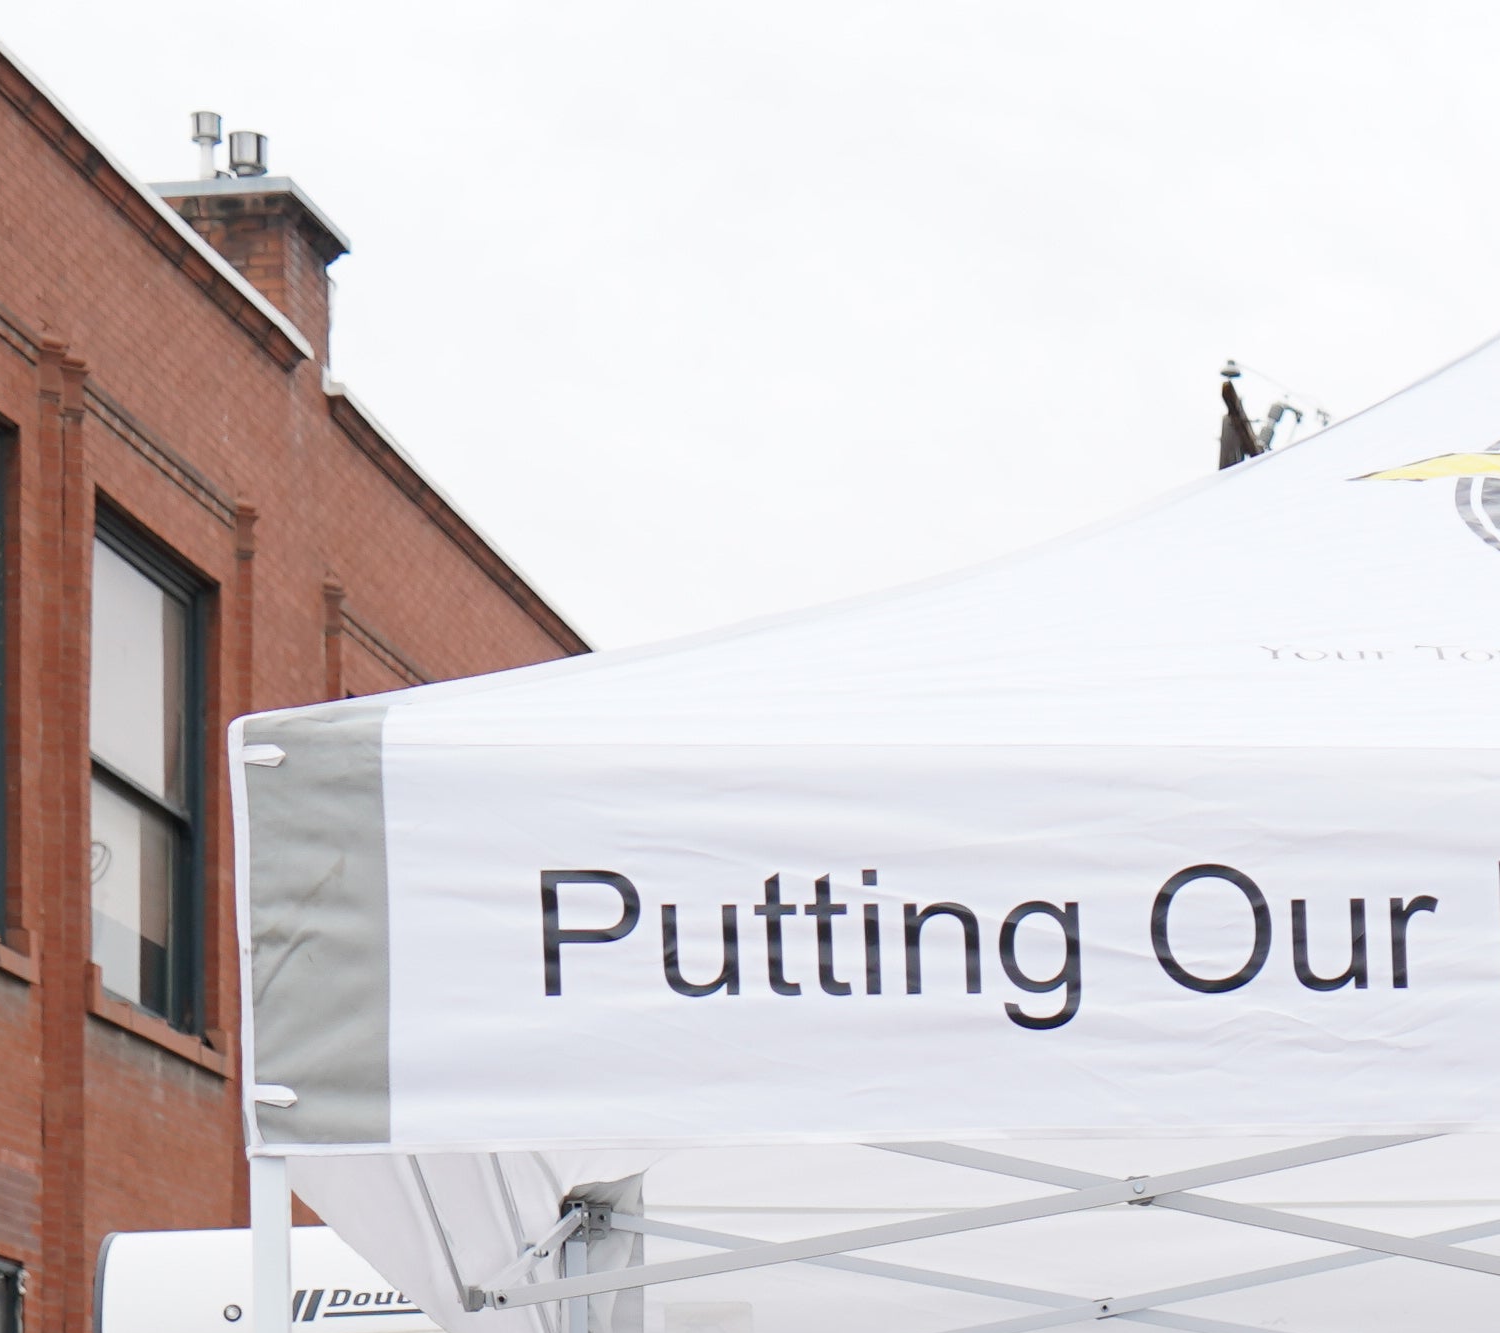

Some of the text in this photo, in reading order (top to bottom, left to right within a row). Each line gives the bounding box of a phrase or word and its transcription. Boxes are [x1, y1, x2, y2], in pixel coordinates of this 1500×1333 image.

[1257, 644, 1393, 662] Your
[538, 866, 1082, 1031] Putting
[1148, 861, 1439, 995] Our
